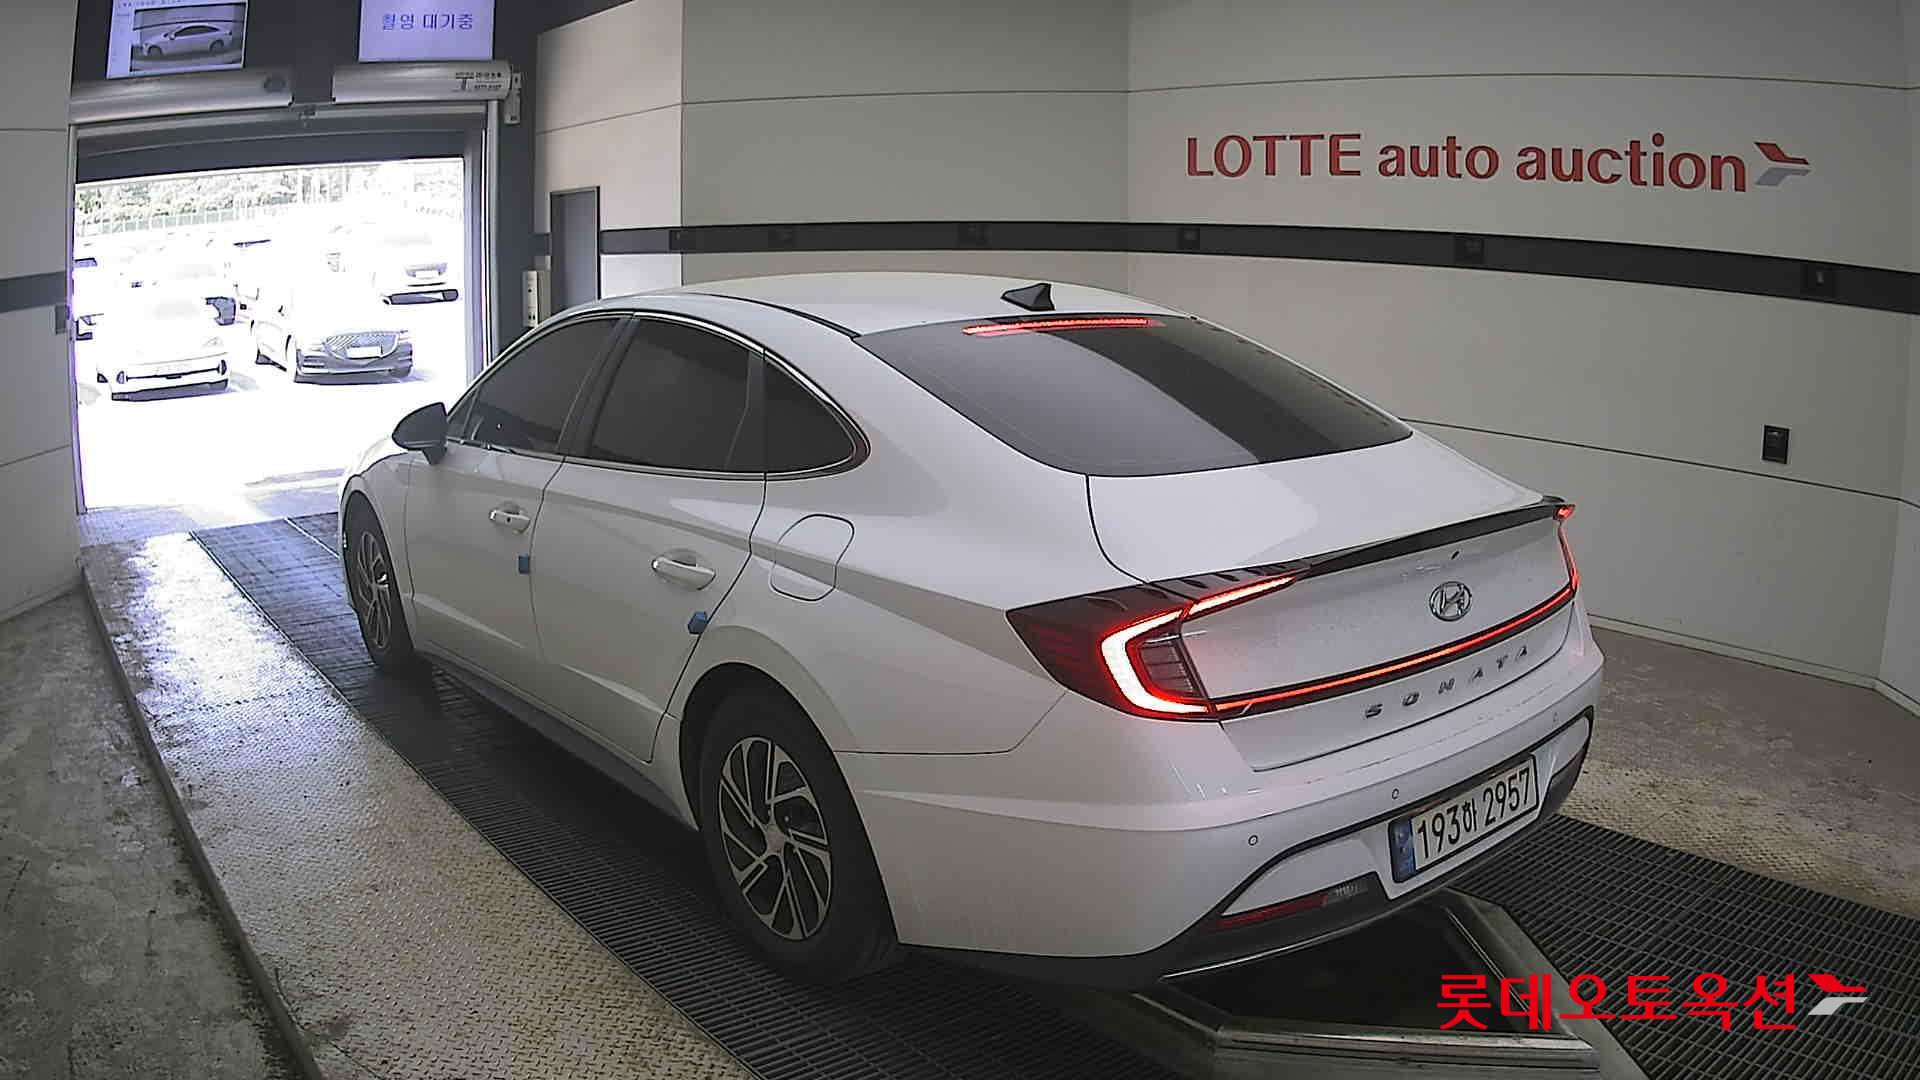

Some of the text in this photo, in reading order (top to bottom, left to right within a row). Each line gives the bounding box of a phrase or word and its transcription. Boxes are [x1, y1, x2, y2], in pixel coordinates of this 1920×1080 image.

[423, 13, 473, 30] 대기중
[1187, 132, 1746, 193] LOTTE auto auction
[1364, 645, 1529, 719] SONATA
[1417, 767, 1530, 858] 193하 2957
